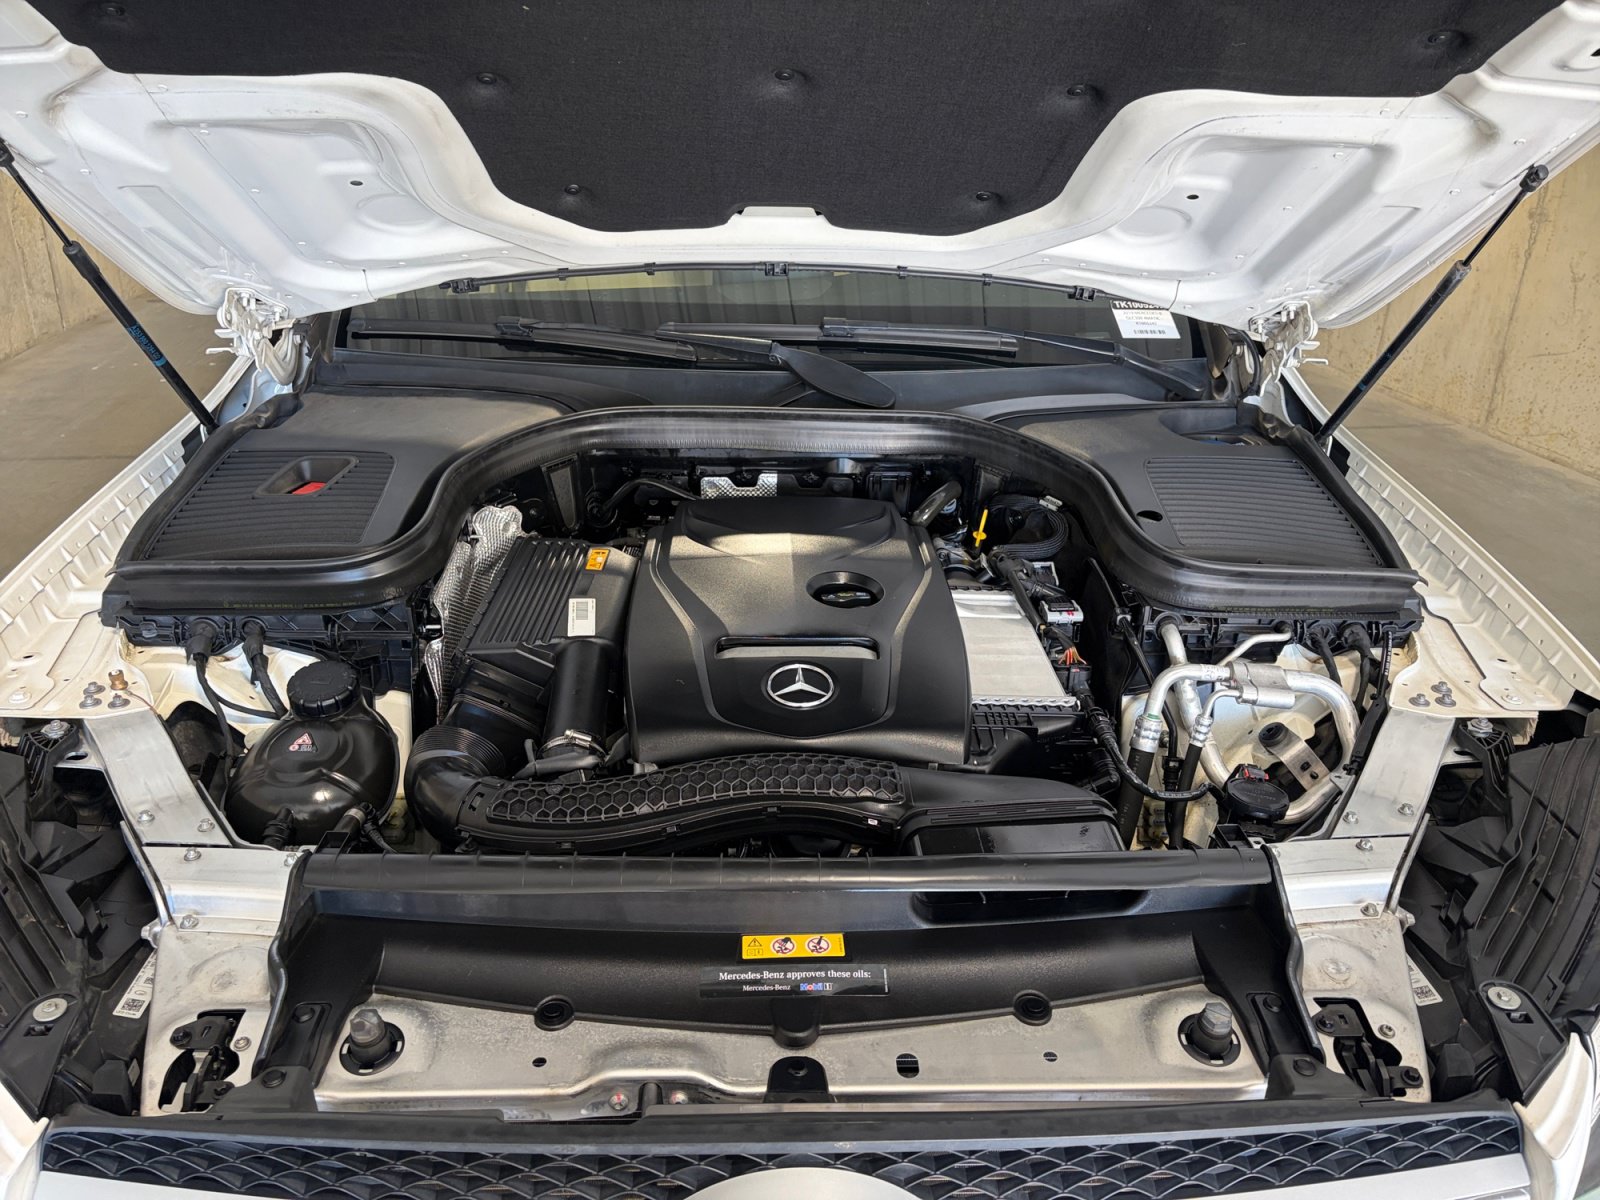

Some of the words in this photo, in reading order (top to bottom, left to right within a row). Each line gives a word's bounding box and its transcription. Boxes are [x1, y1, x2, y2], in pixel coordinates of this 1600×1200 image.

[719, 971, 785, 980] Mercedes-Benz
[786, 970, 826, 980] approves
[827, 969, 851, 978] these
[852, 969, 872, 978] oils:
[742, 984, 791, 992] Mercedes-Benz
[799, 983, 824, 991] Mobil
